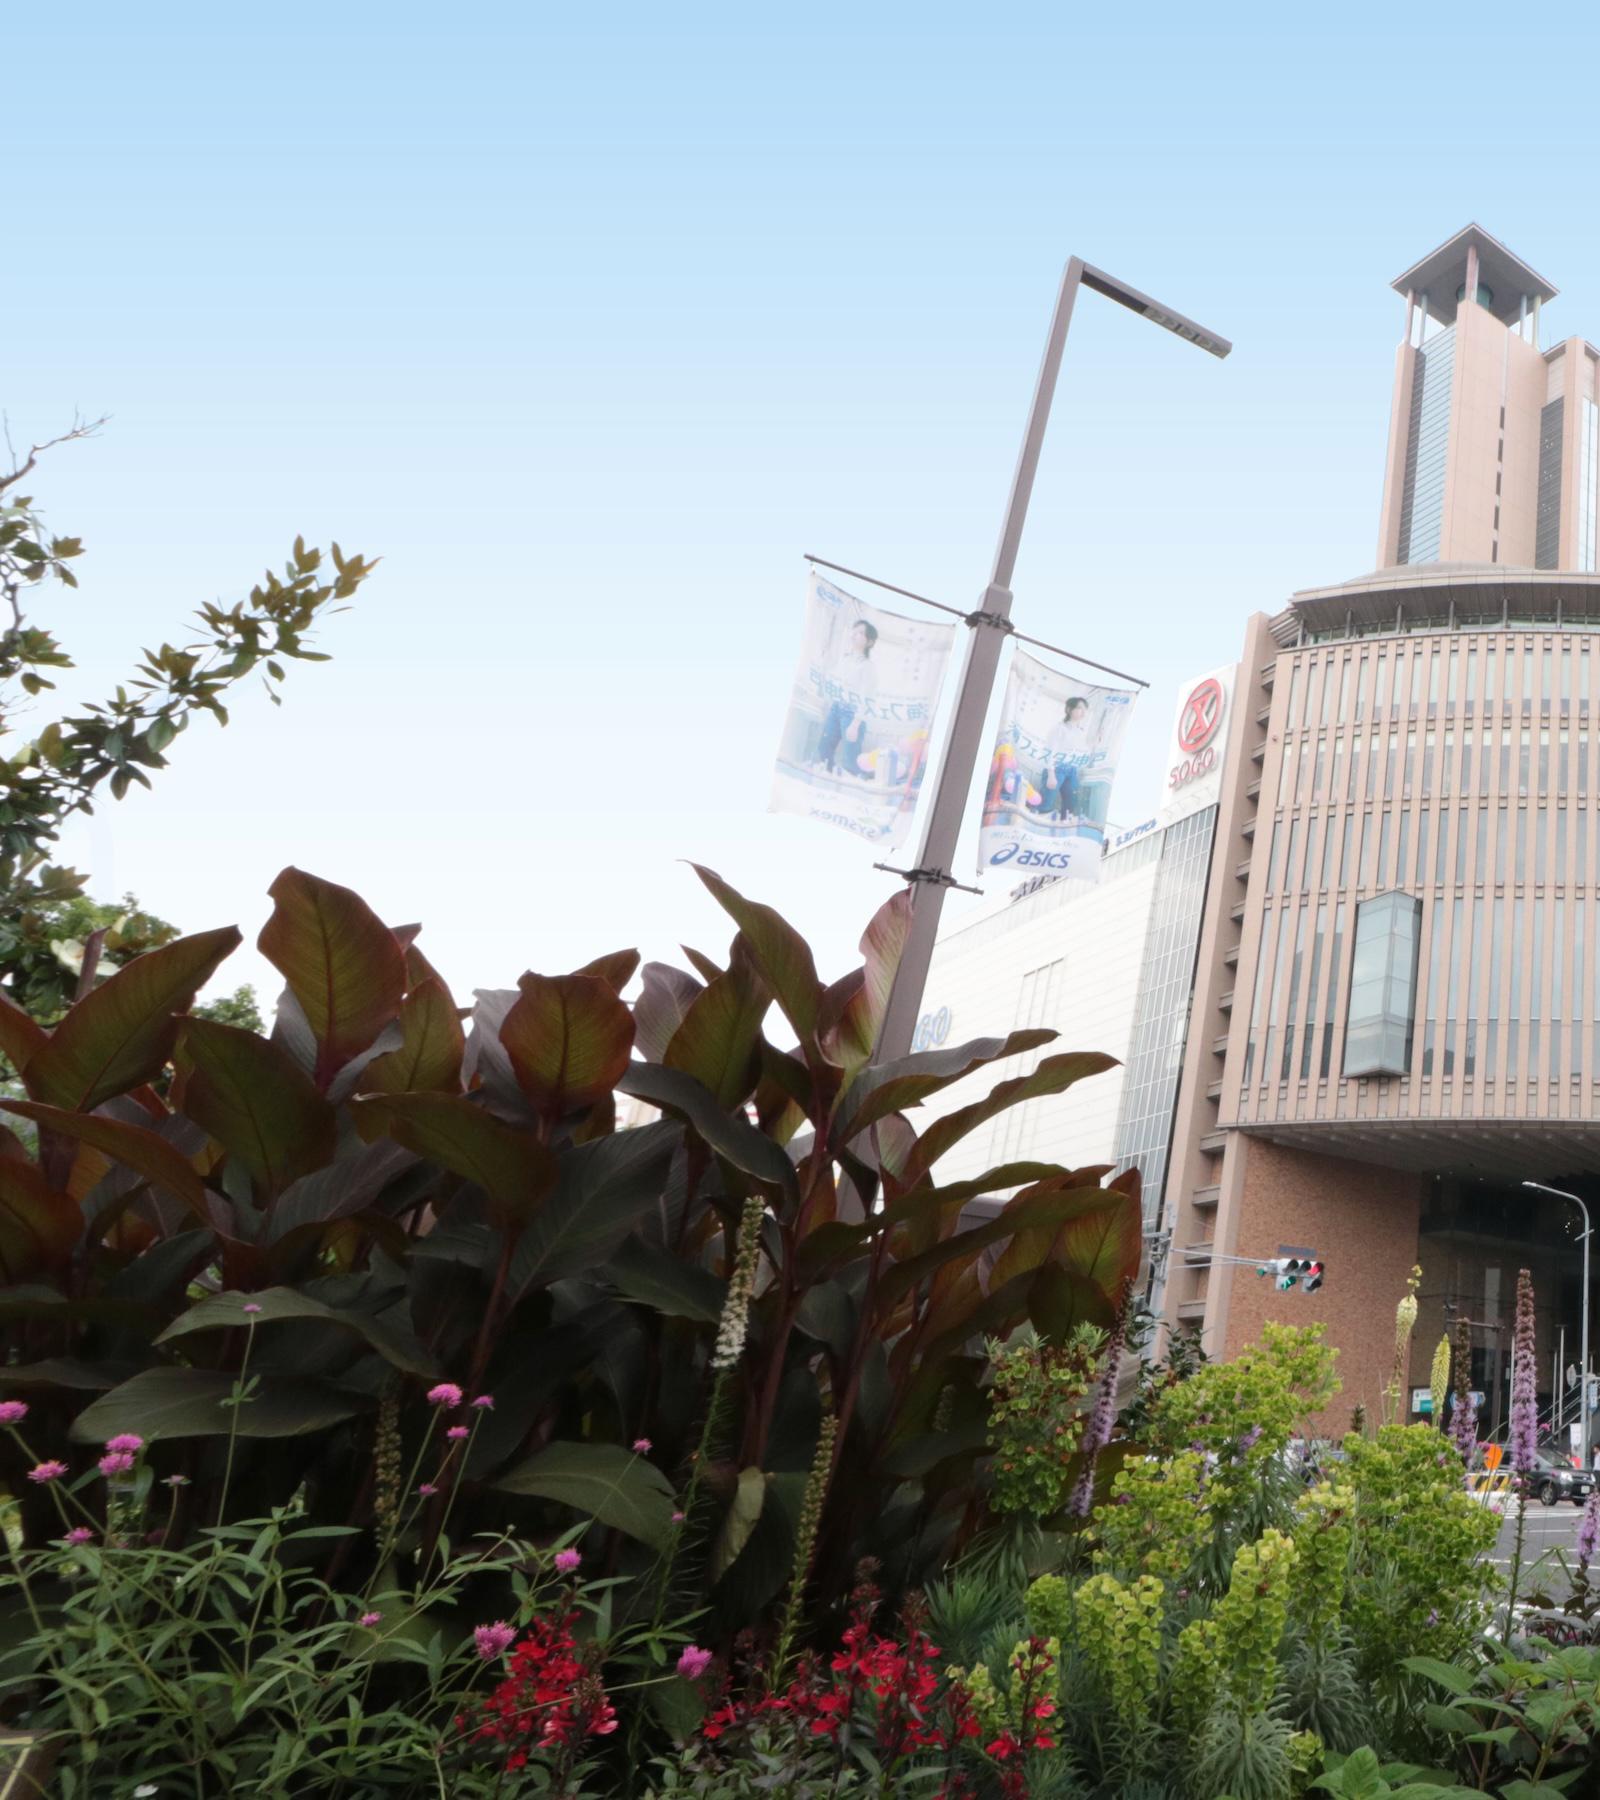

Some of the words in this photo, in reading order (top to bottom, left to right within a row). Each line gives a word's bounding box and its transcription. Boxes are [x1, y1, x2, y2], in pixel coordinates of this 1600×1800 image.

[1168, 747, 1216, 790] SOGO
[1017, 849, 1071, 869] asics
[911, 1006, 951, 1052] GO
